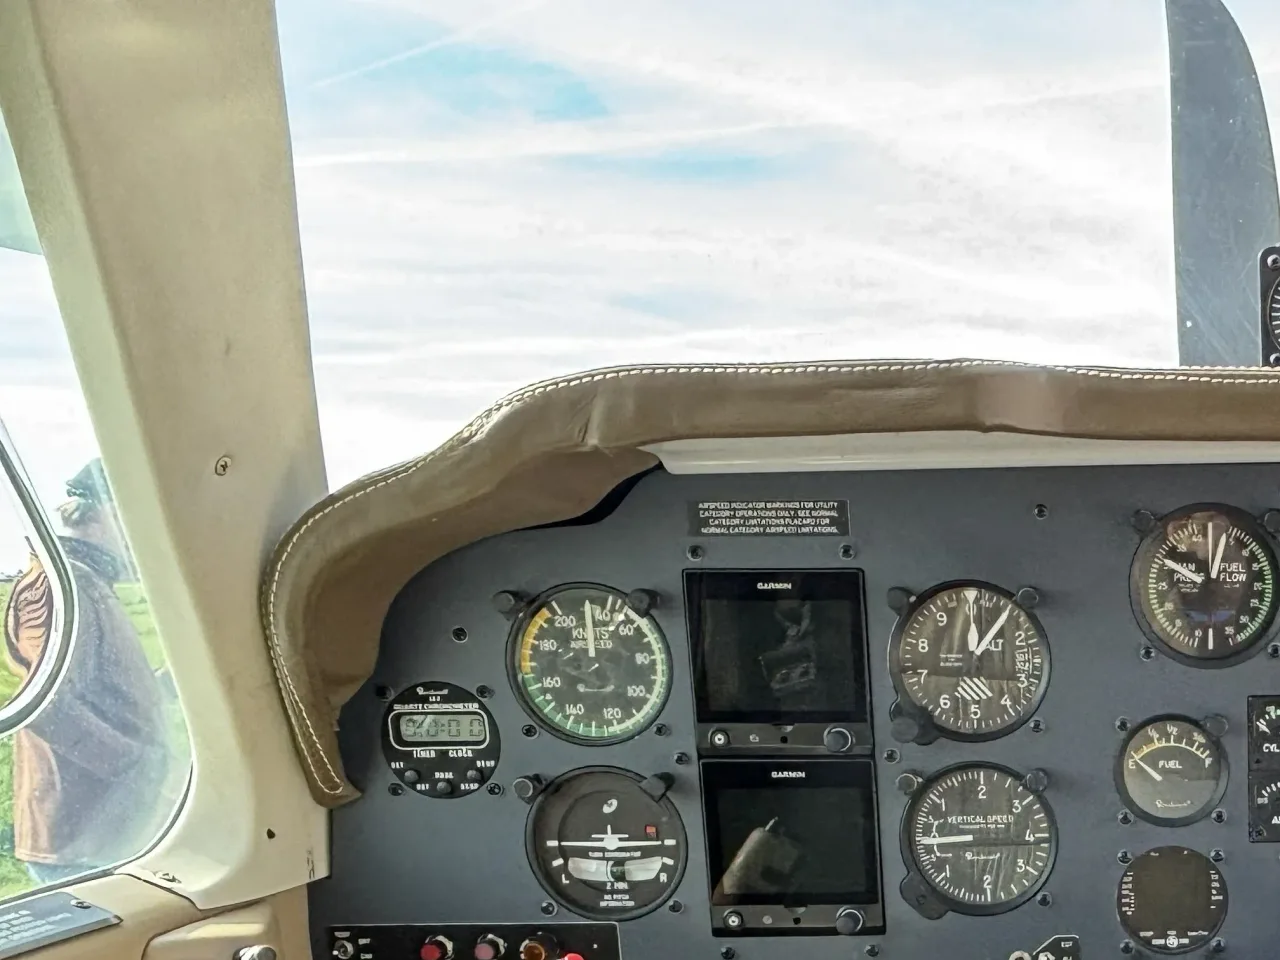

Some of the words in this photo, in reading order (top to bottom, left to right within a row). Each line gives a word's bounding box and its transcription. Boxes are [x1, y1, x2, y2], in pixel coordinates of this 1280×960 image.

[1219, 563, 1246, 573] FUEL
[1219, 573, 1247, 582] FLOW
[554, 615, 576, 628] 200
[936, 611, 948, 627] 9
[618, 624, 634, 636] 60
[1014, 630, 1026, 646] 2
[918, 638, 929, 653] 8
[917, 669, 928, 684] 7
[627, 685, 646, 697] 100
[939, 694, 951, 709] 6
[565, 703, 585, 715] 140
[603, 707, 622, 719] 120
[970, 704, 981, 719] 5
[1262, 743, 1280, 753] CYL
[1128, 759, 1136, 769] E
[1158, 760, 1183, 769] FUEL
[977, 785, 987, 799] 2
[1012, 799, 1022, 814] 3
[947, 815, 986, 824] VERTICAL
[986, 815, 1014, 823] SPEED
[1025, 829, 1035, 842] 4
[1016, 858, 1025, 873] 3
[561, 873, 570, 885] L
[659, 872, 668, 883] R
[983, 874, 993, 889] 2
